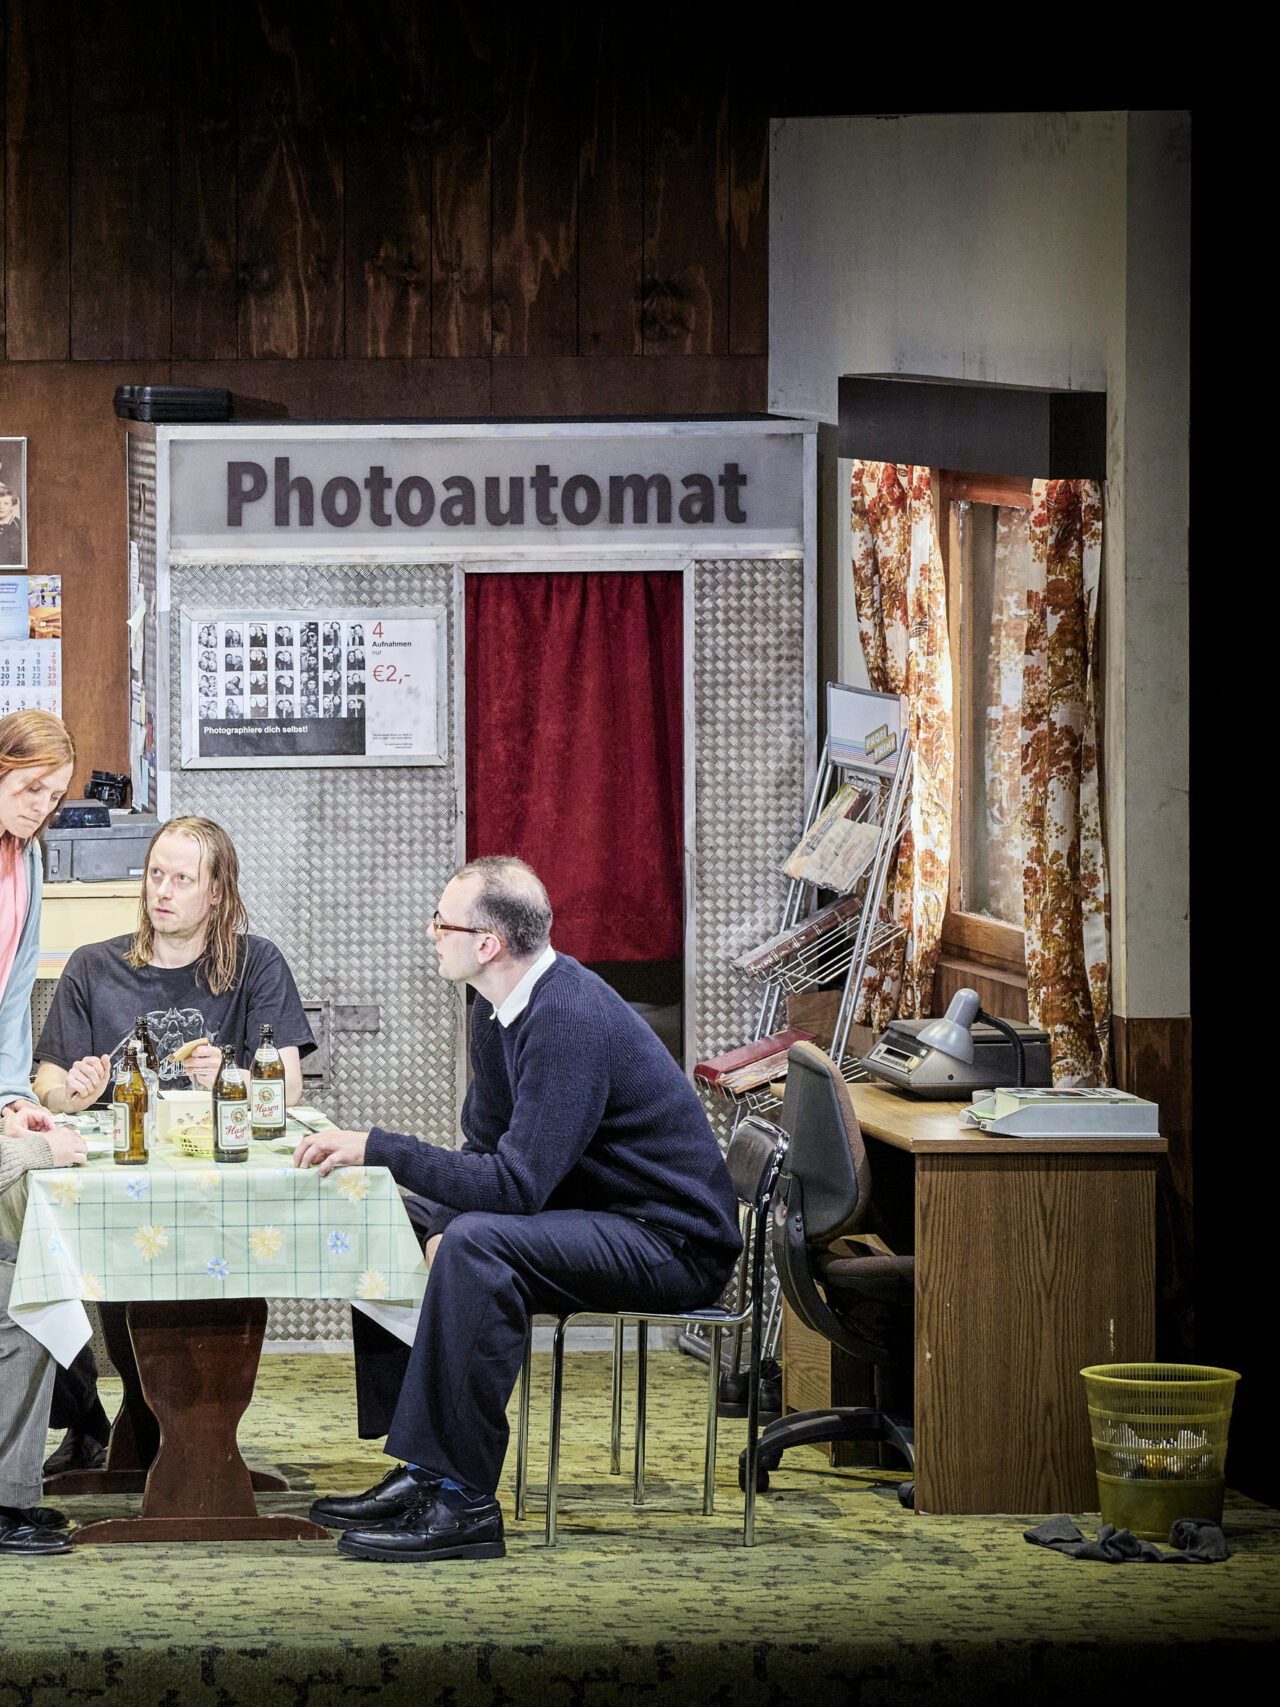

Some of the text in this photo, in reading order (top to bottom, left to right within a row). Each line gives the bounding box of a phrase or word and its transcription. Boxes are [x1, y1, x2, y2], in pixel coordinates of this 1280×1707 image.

[227, 457, 748, 527] Photoautomat
[372, 622, 384, 638] 4
[371, 640, 412, 648] Aufnahmen
[372, 664, 411, 685] €2,-
[204, 725, 309, 736] Photographiere dich selbst!
